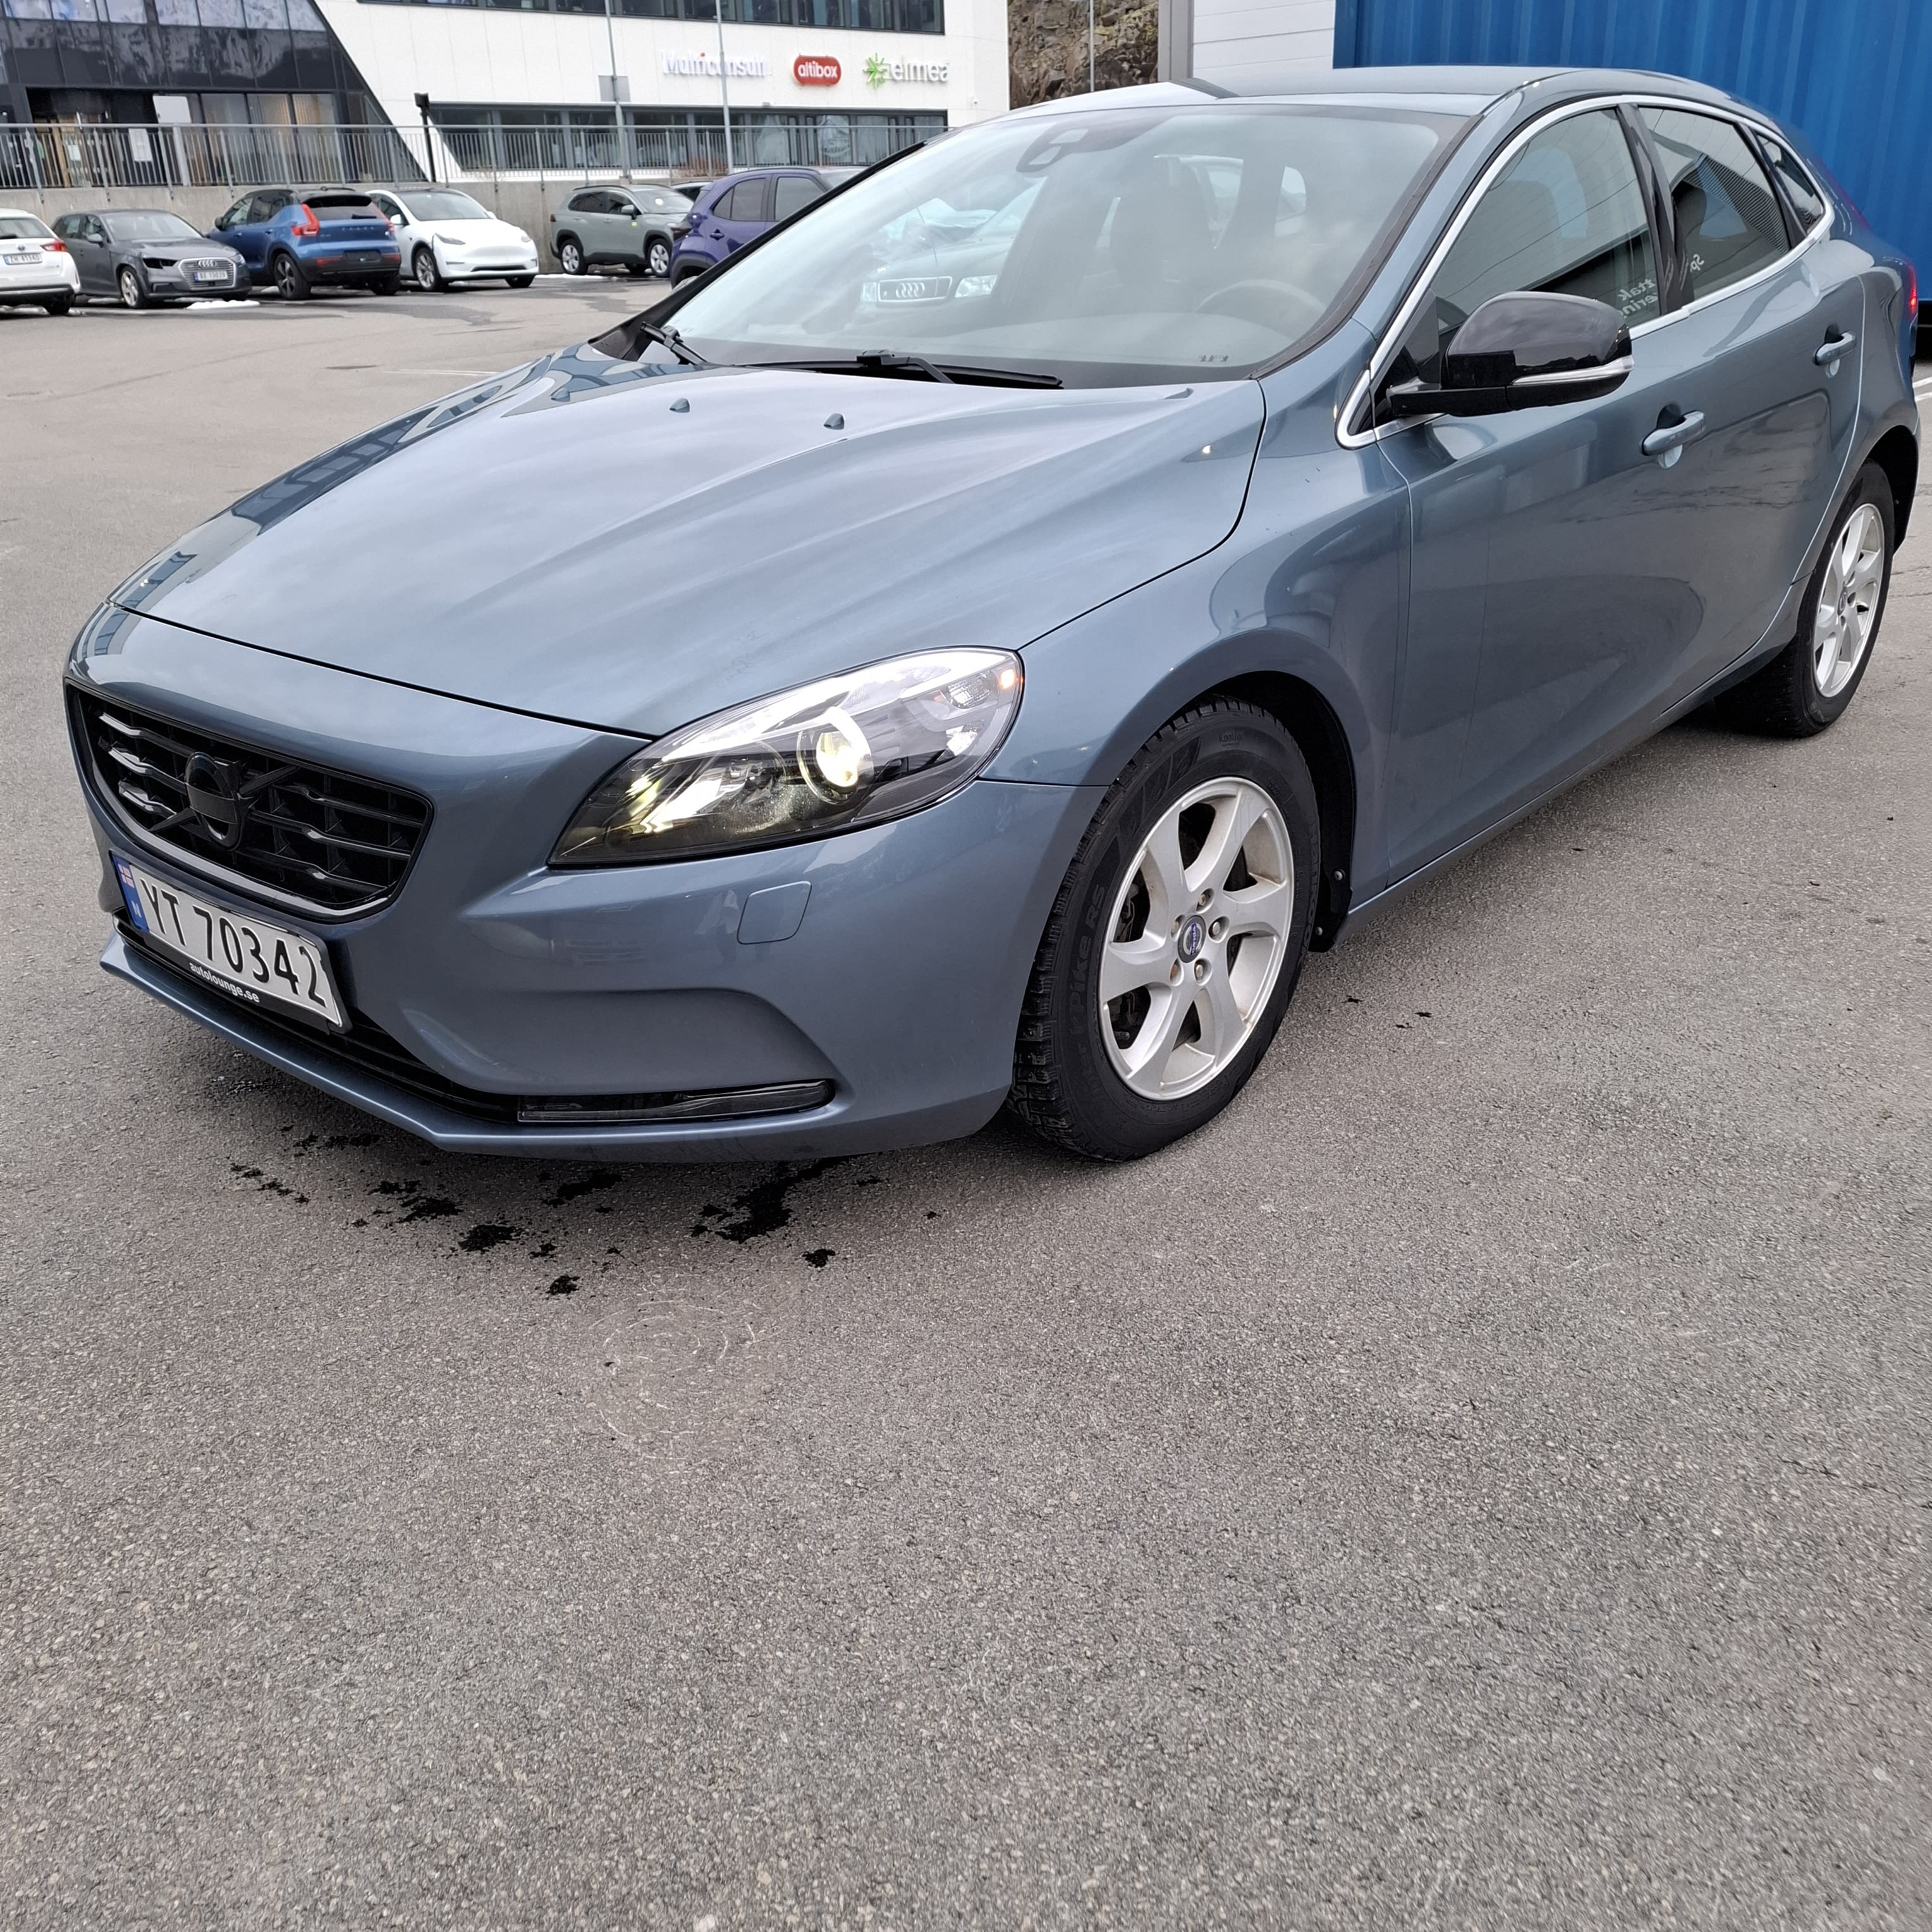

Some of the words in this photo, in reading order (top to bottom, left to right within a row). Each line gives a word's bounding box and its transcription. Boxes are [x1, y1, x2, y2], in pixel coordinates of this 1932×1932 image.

[662, 50, 771, 76] Multicnsult
[797, 61, 838, 78] altibox
[132, 899, 142, 918] N
[140, 877, 185, 947] YT
[192, 905, 327, 1008] 70342
[189, 962, 260, 1003] autolounge.se
